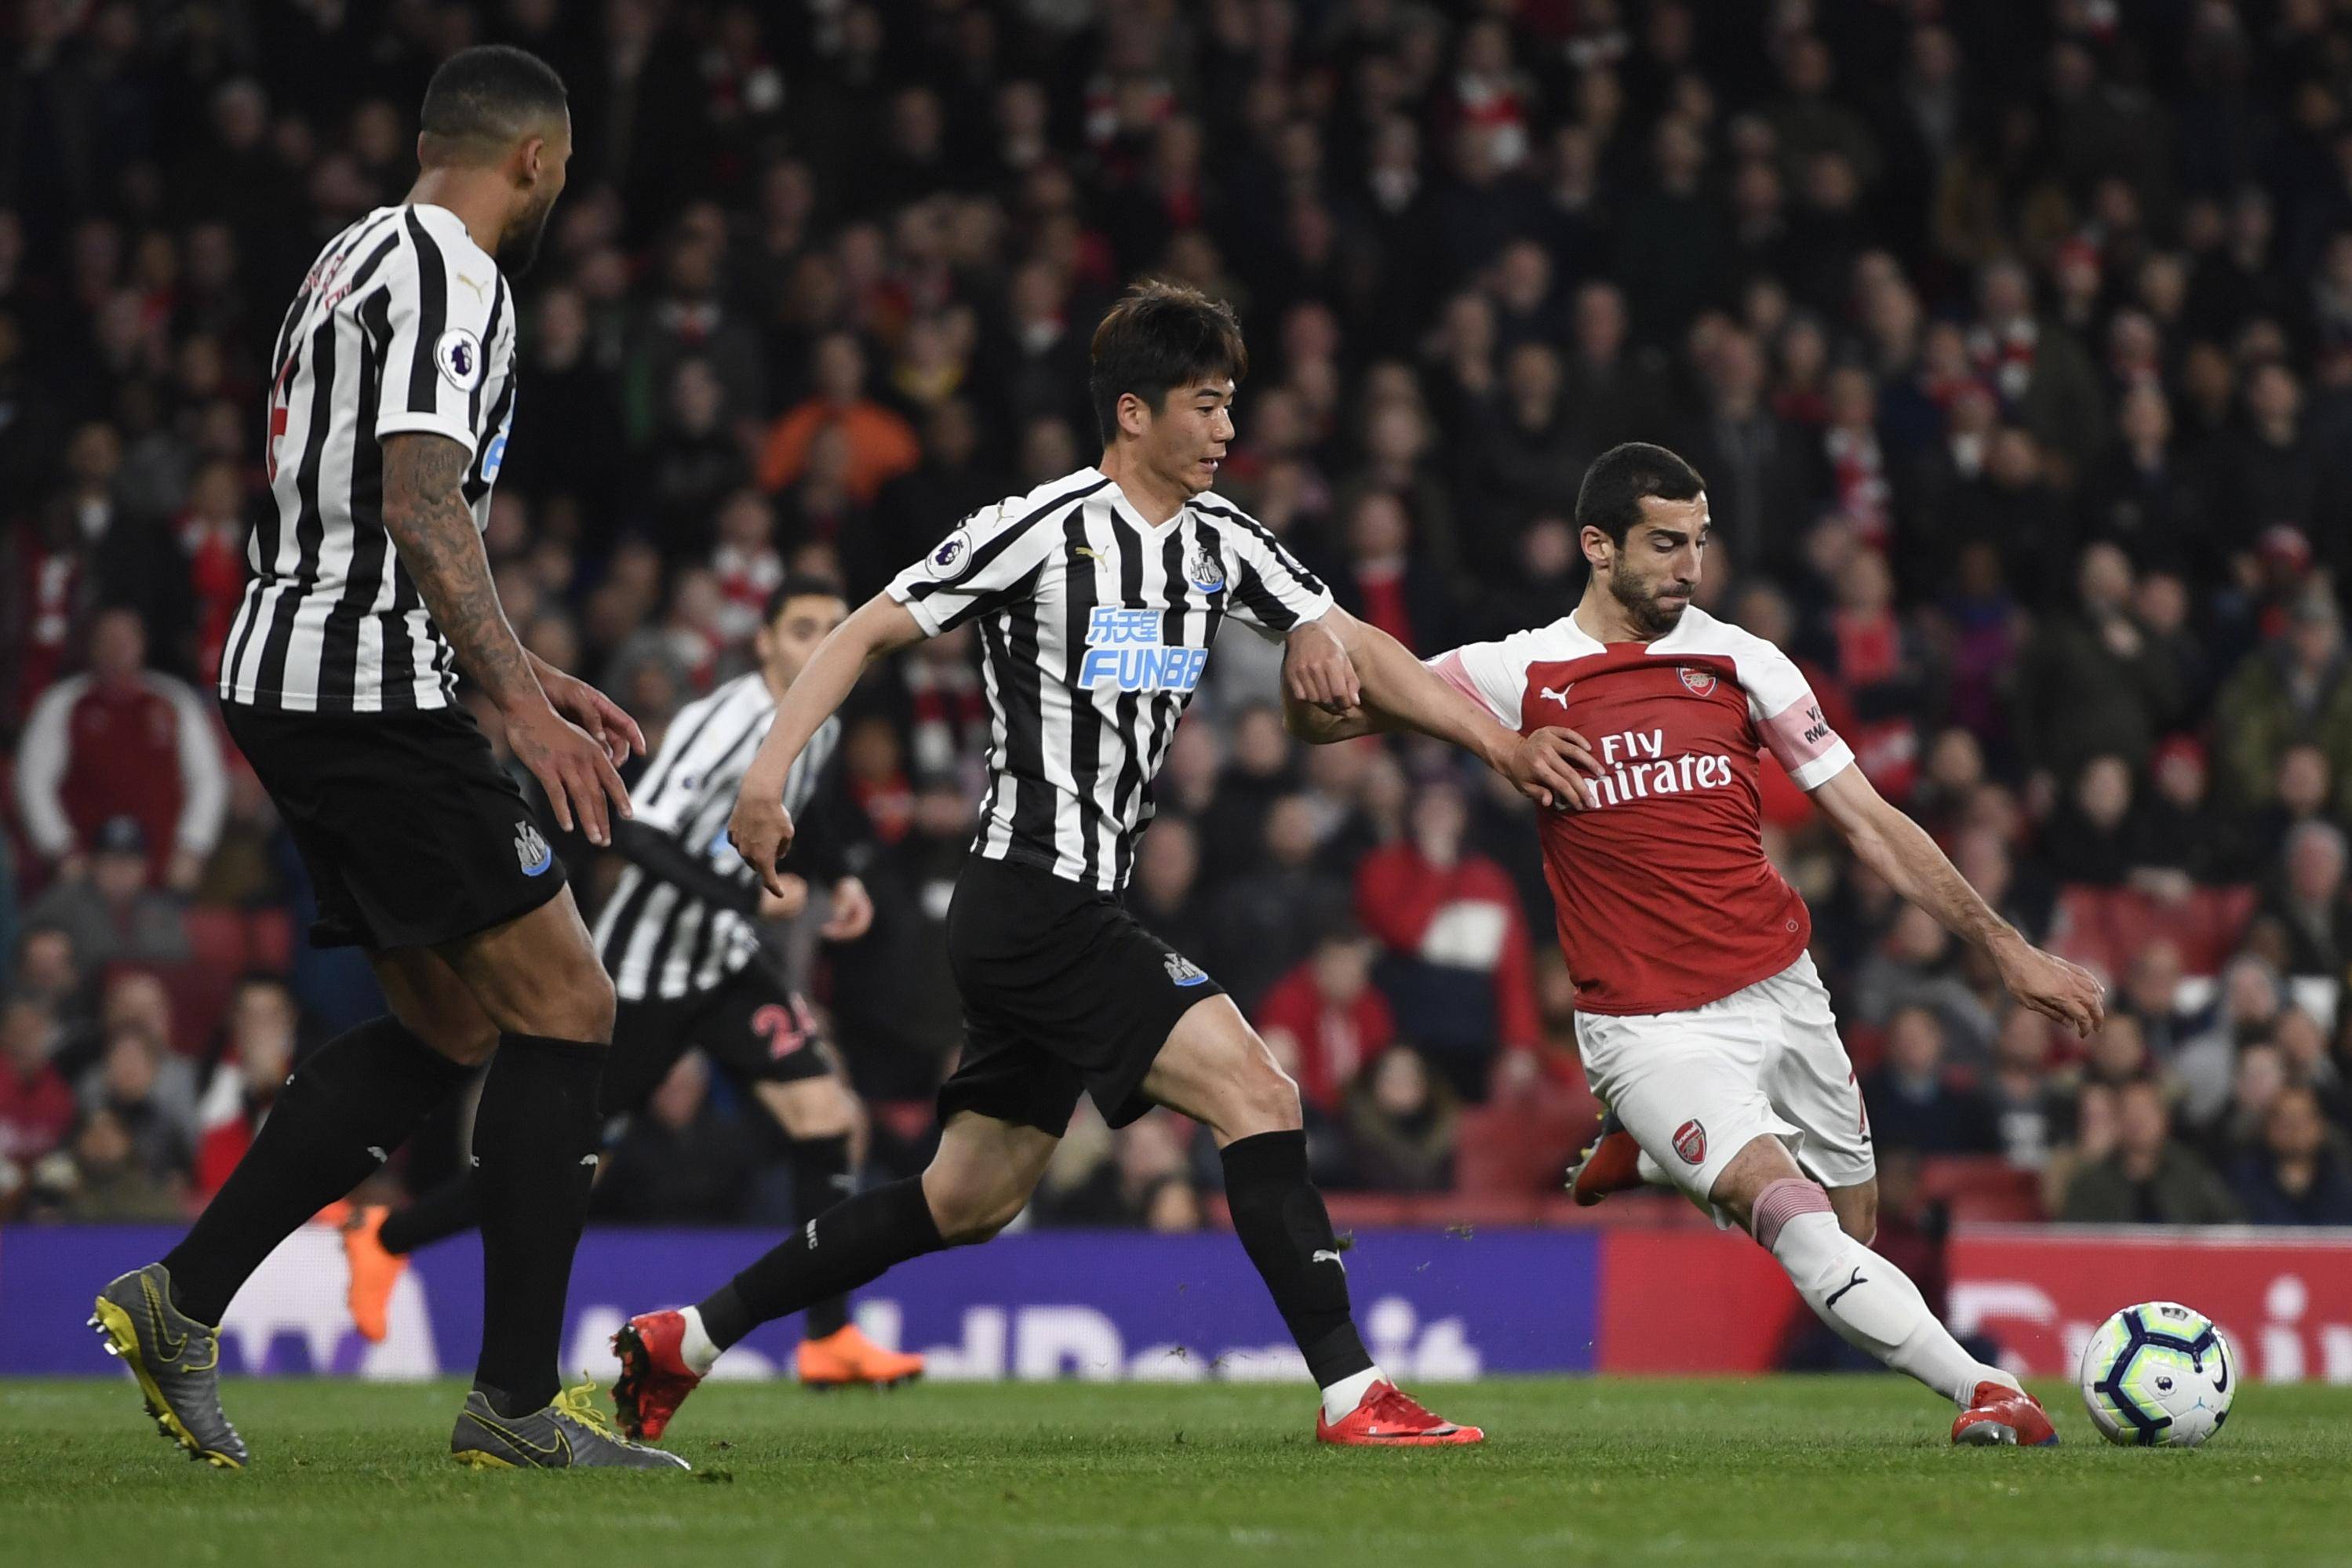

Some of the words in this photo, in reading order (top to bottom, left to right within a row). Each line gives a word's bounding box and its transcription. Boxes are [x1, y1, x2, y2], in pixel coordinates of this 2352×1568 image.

[1087, 607, 1160, 644] 乐天堂
[1080, 648, 1207, 690] FUN88
[1600, 729, 1663, 765] Fly
[1555, 751, 1732, 809] mirates
